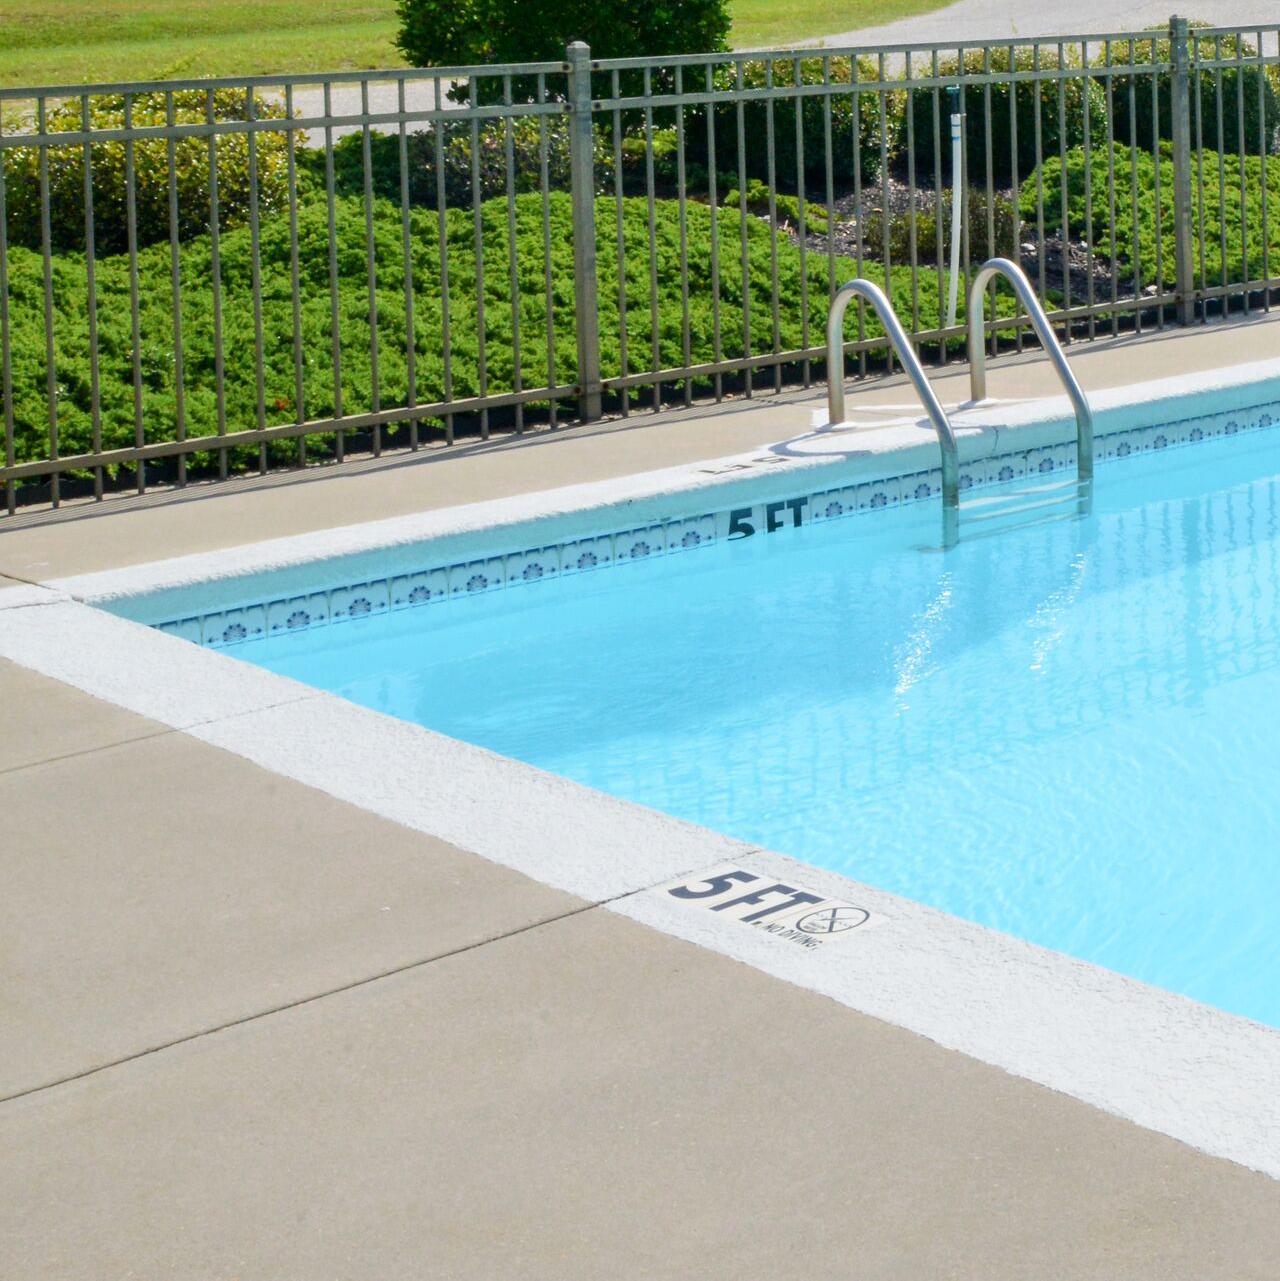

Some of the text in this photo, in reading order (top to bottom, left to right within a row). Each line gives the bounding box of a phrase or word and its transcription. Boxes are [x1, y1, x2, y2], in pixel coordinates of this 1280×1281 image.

[727, 496, 809, 541] 5 FT
[668, 870, 826, 924] 5 FT
[765, 922, 823, 951] NO DIVING
